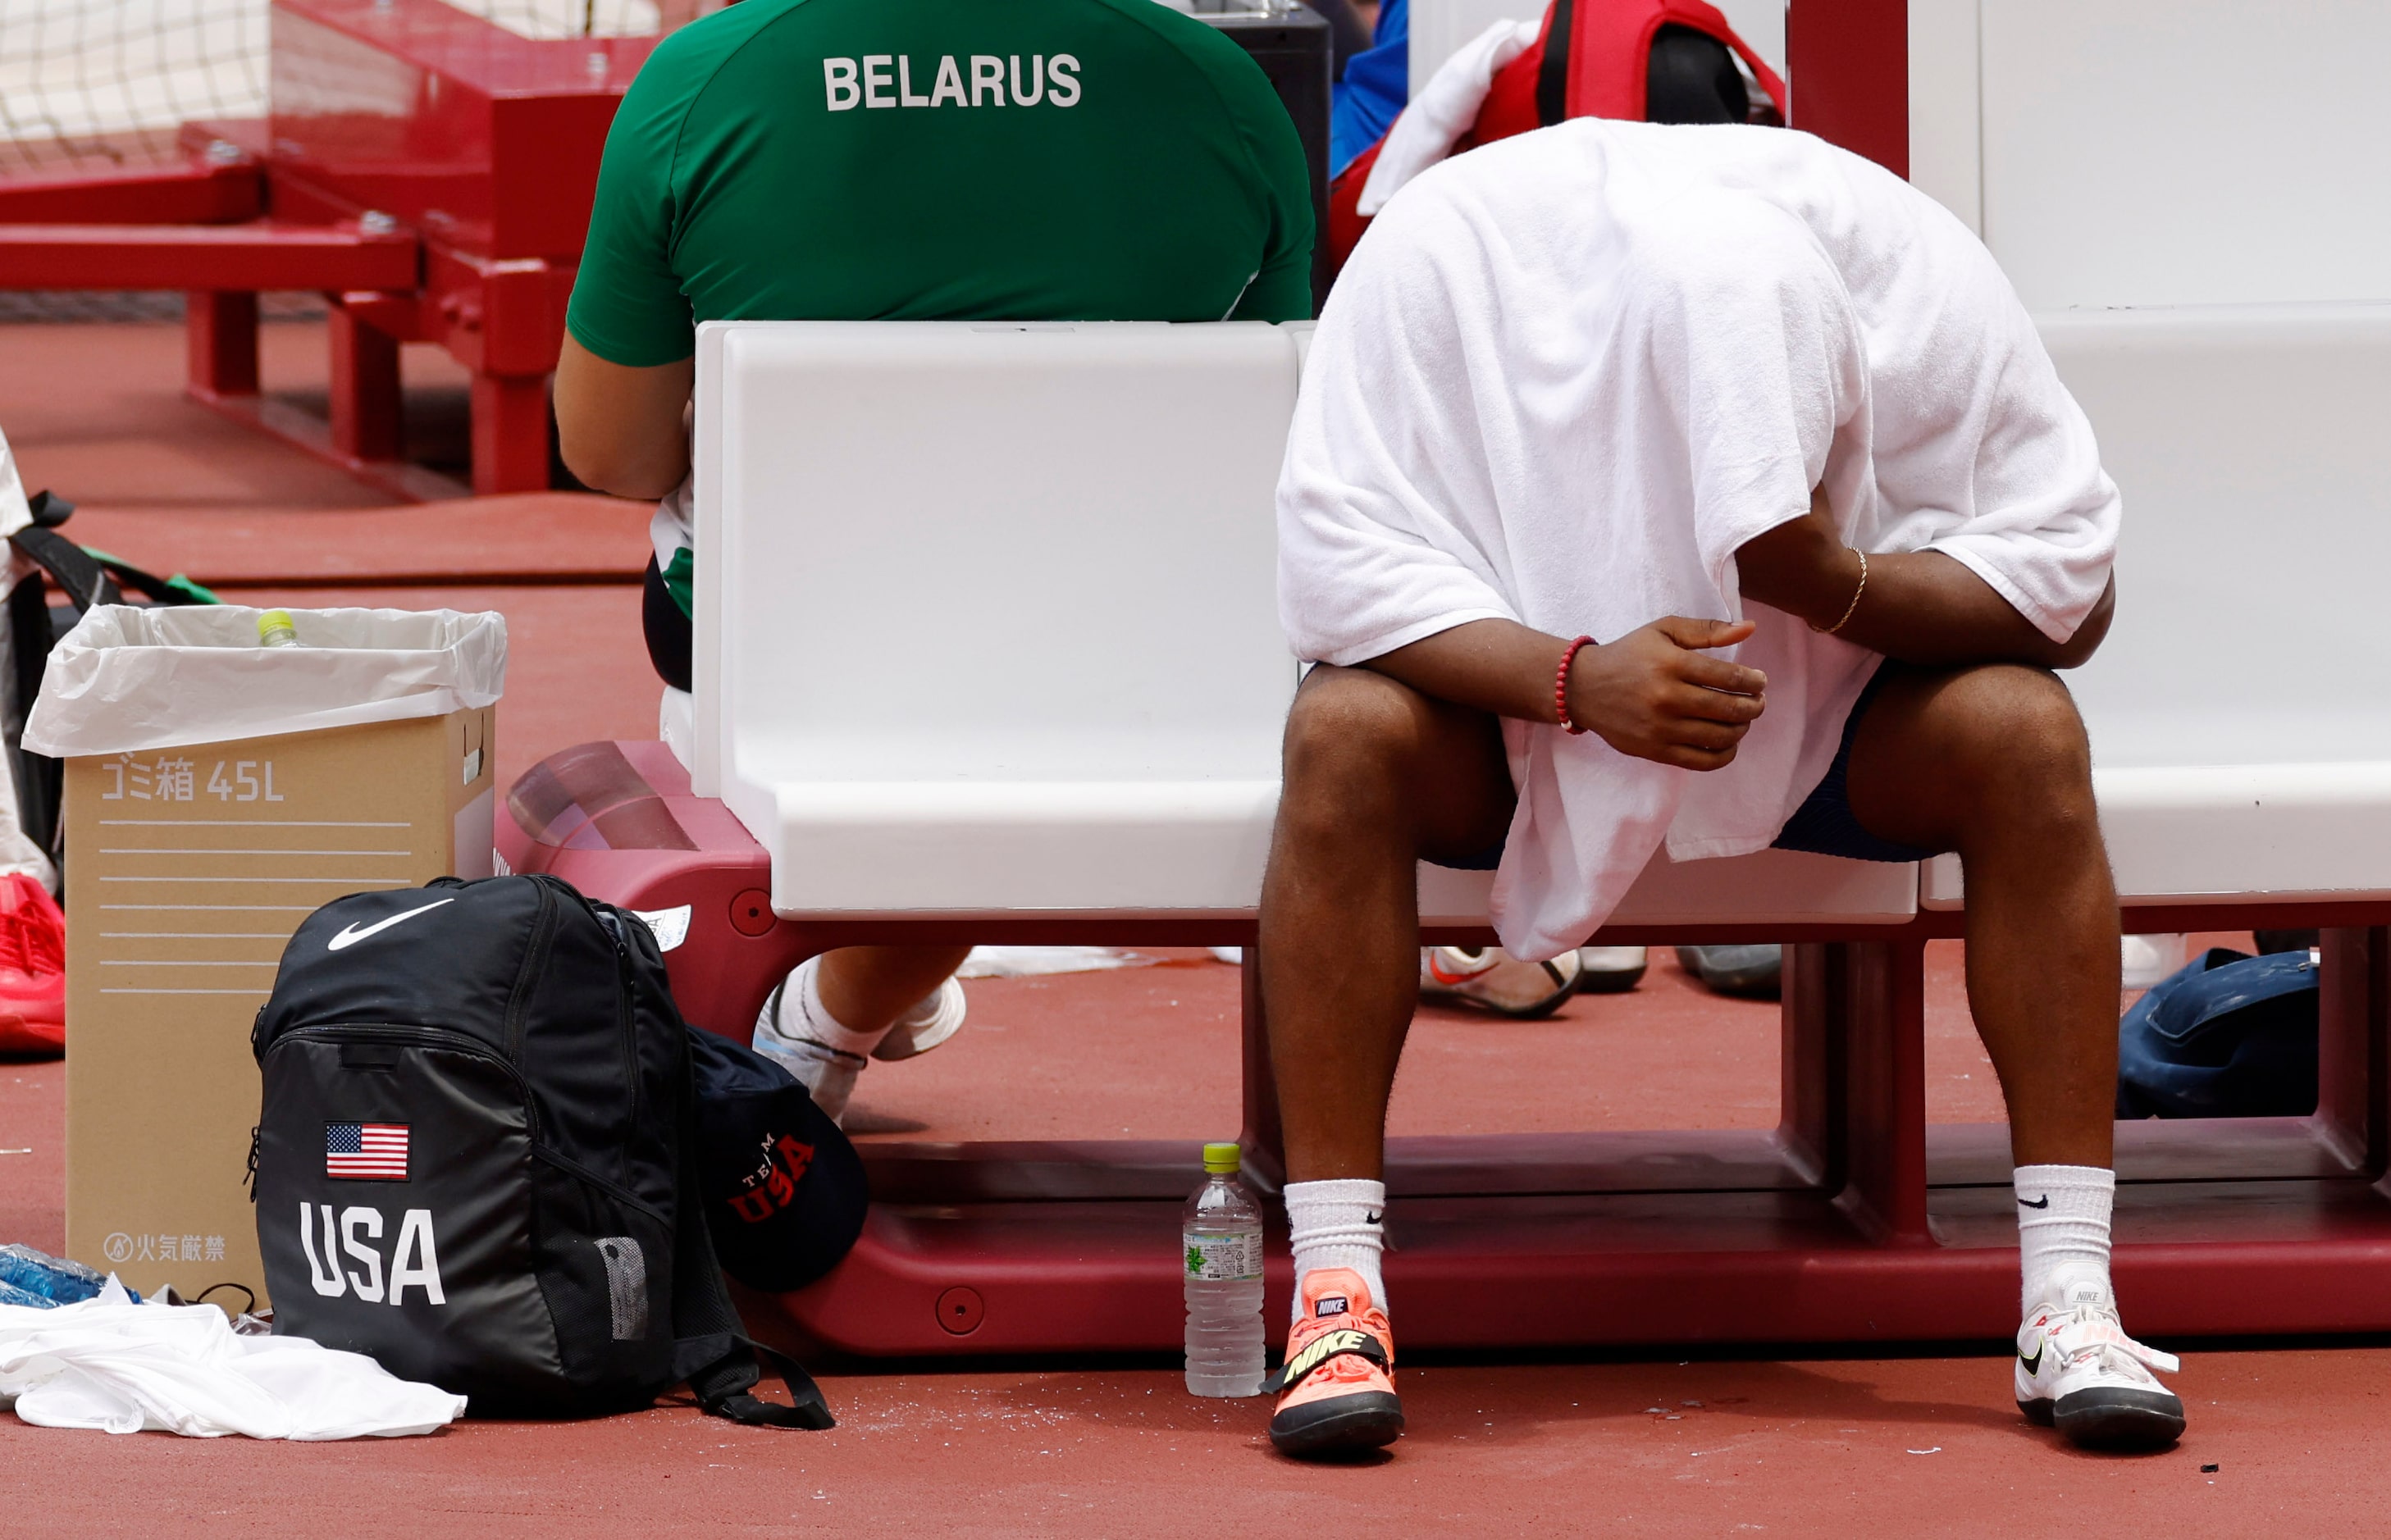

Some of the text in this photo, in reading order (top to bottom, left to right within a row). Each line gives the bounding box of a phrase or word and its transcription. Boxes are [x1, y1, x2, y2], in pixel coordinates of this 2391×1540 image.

[823, 53, 1081, 112] BELARUS
[102, 750, 285, 801] ゴミ箱 45L
[726, 1133, 815, 1223] USA
[137, 1233, 226, 1262] 火気厳禁
[299, 1201, 447, 1306] USA
[1317, 1298, 1345, 1315] NIKE
[2075, 1291, 2100, 1301] NIKE
[1284, 1329, 1367, 1384] NIKE
